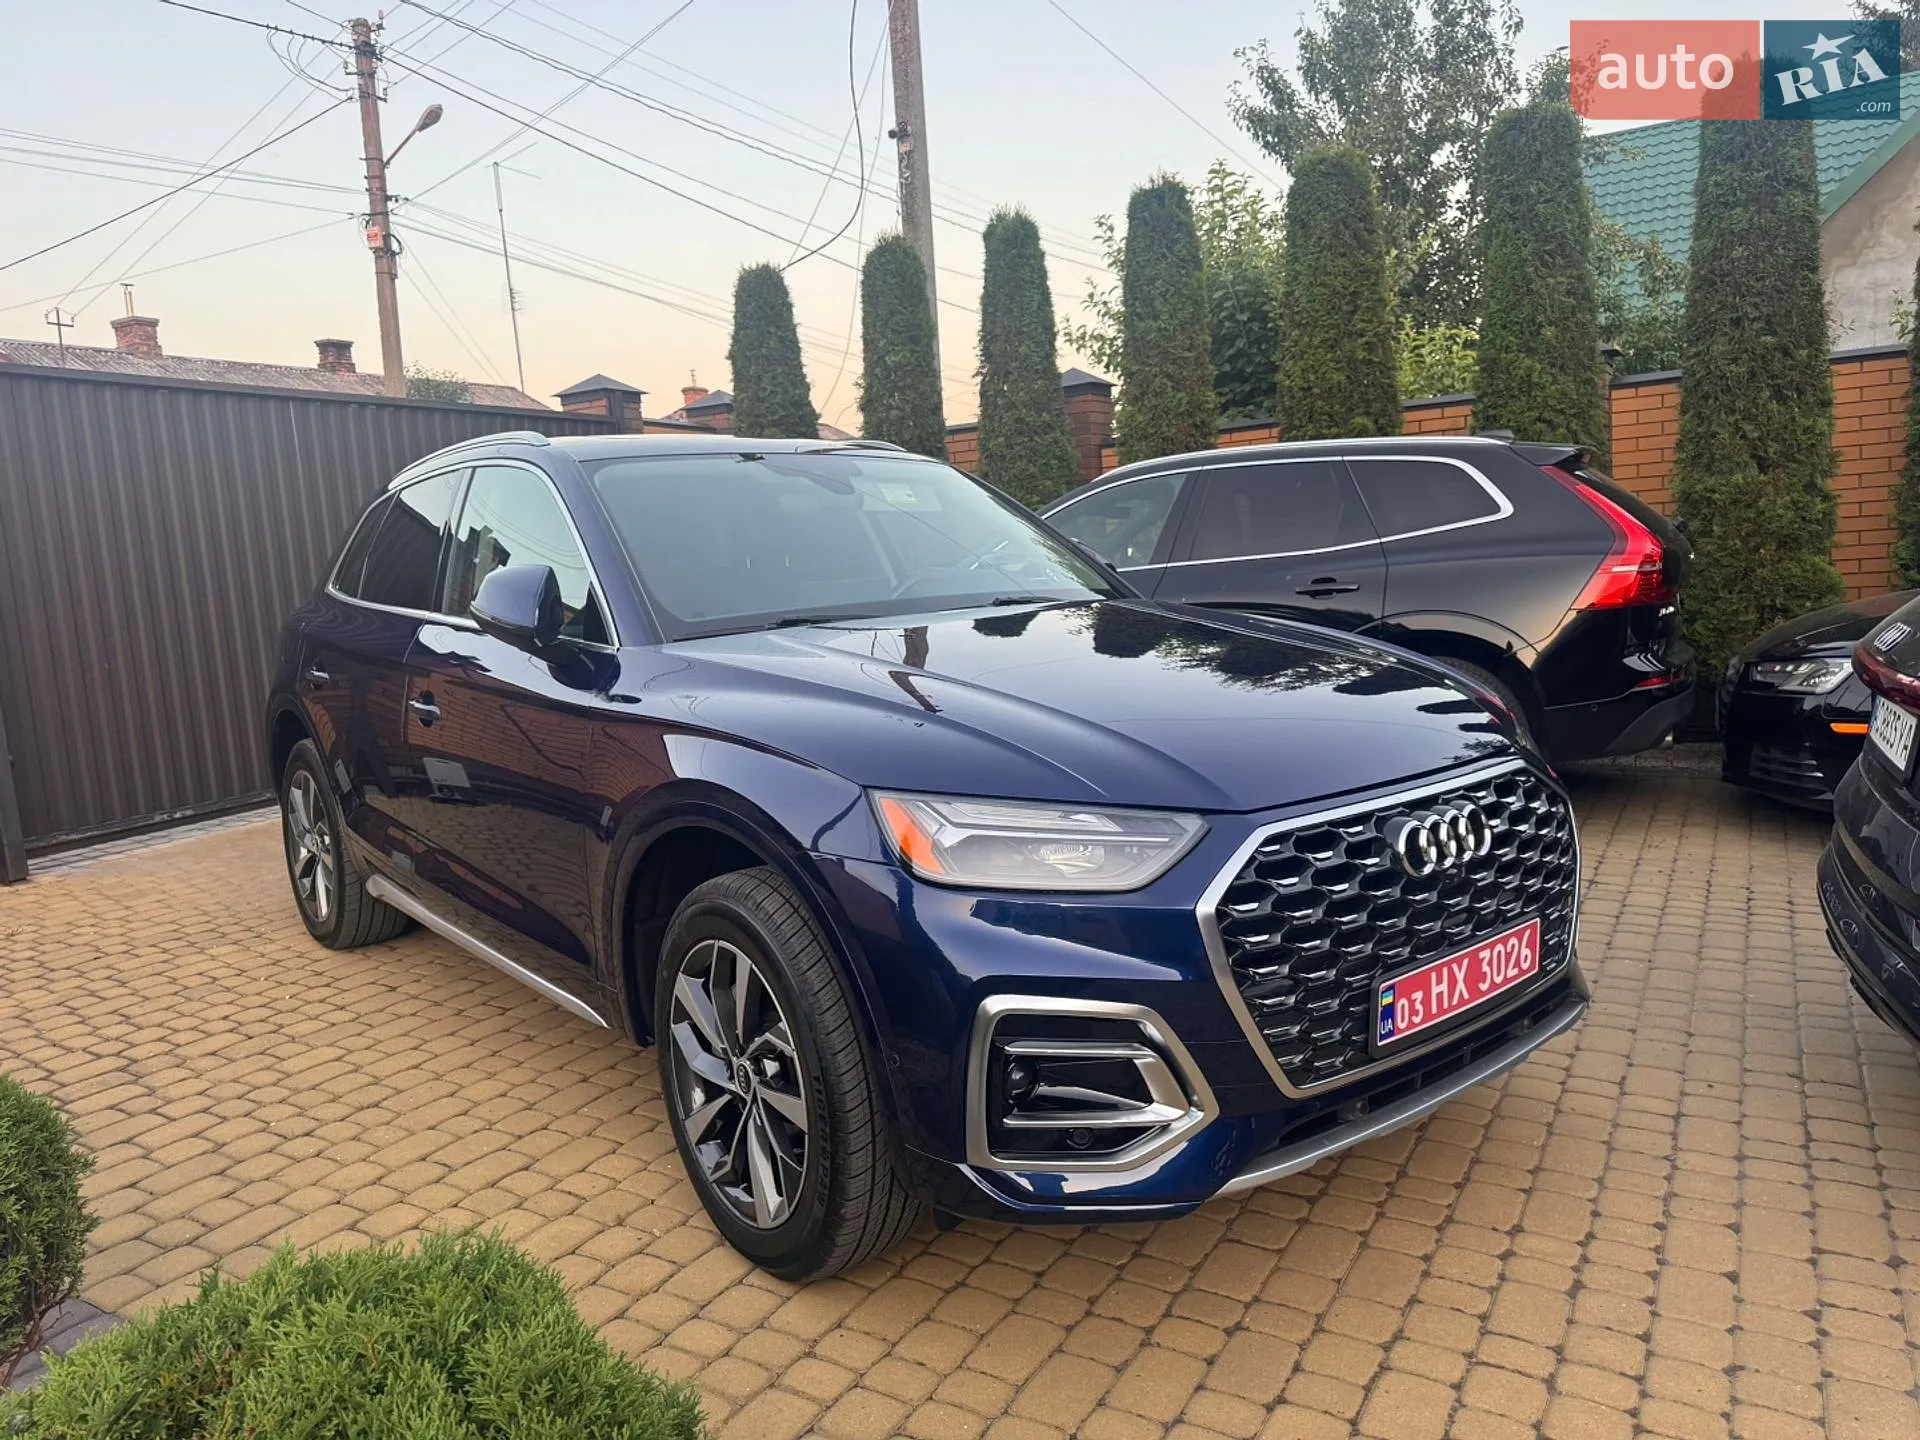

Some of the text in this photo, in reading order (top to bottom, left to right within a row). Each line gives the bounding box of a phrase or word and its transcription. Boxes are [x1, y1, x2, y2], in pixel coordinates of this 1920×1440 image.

[1397, 928, 1532, 1029] 03 HX 3026
[1380, 1017, 1394, 1035] UA
